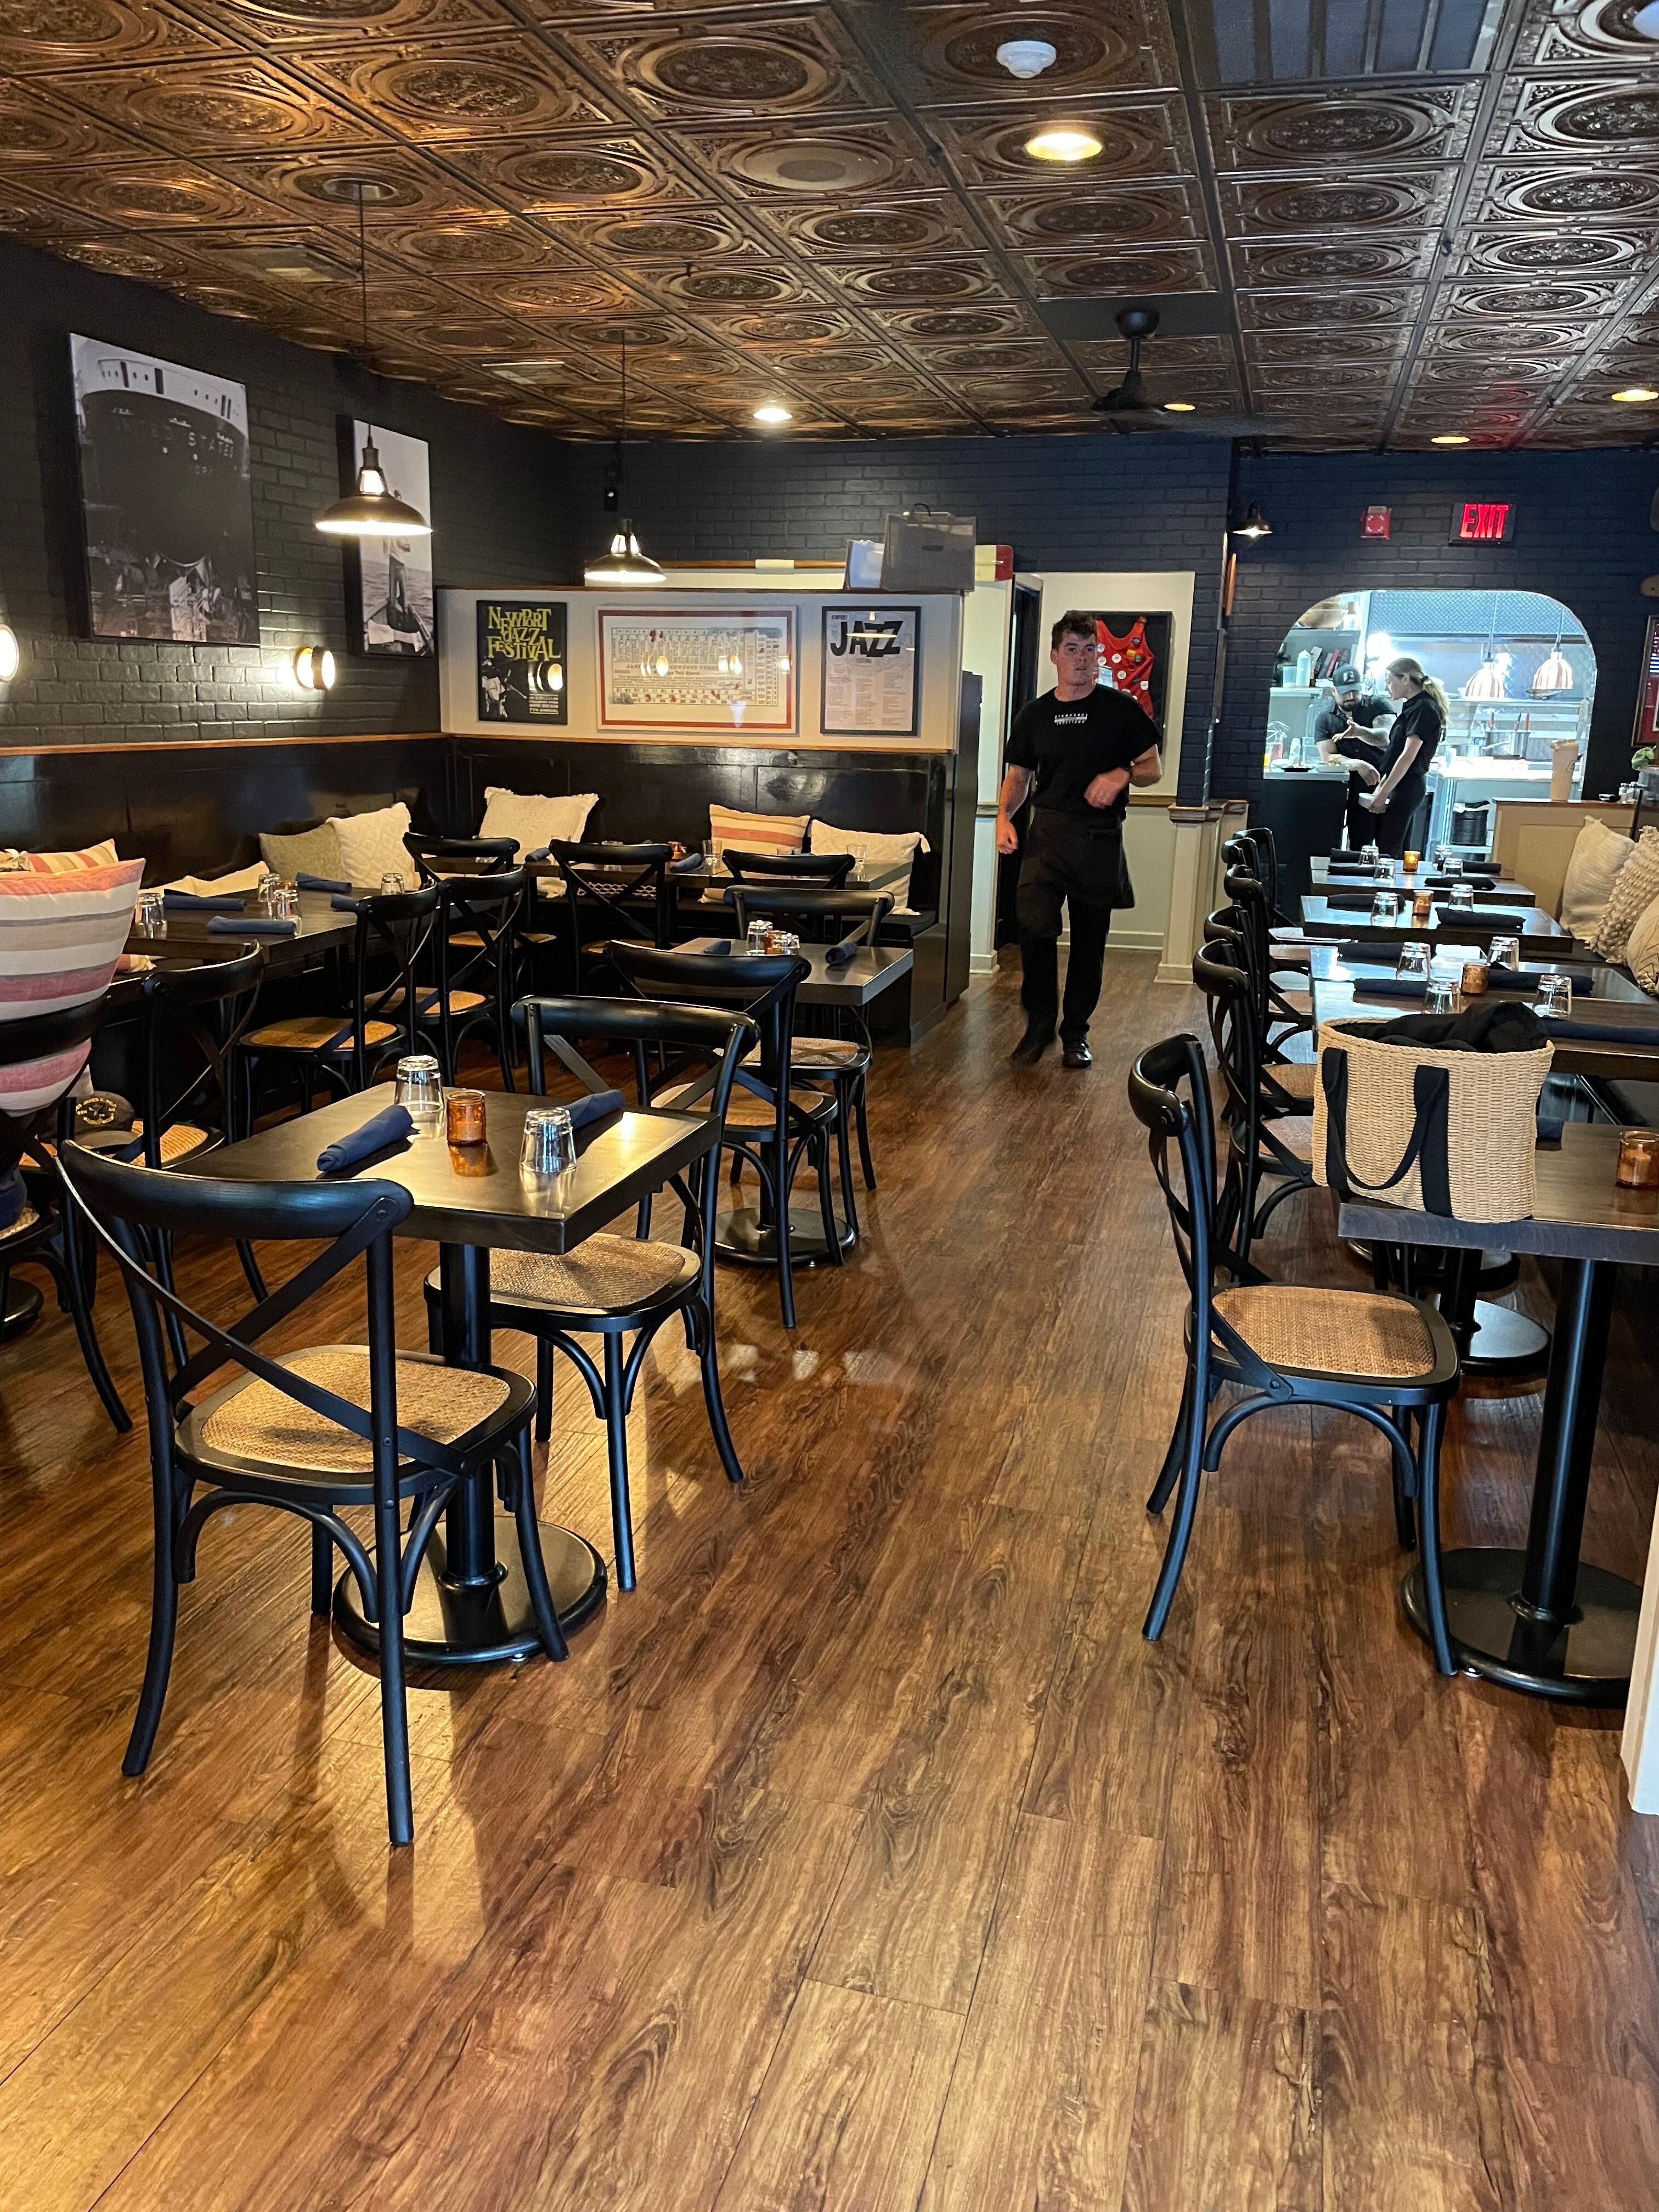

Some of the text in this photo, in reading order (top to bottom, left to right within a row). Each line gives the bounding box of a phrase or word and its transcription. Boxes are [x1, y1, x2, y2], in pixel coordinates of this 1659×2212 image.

[1460, 504, 1509, 538] EXIT
[488, 606, 552, 632] NEWPORT
[486, 636, 561, 662] FESTIVAL
[501, 627, 540, 645] JAZZ
[830, 620, 904, 657] JAZZ
